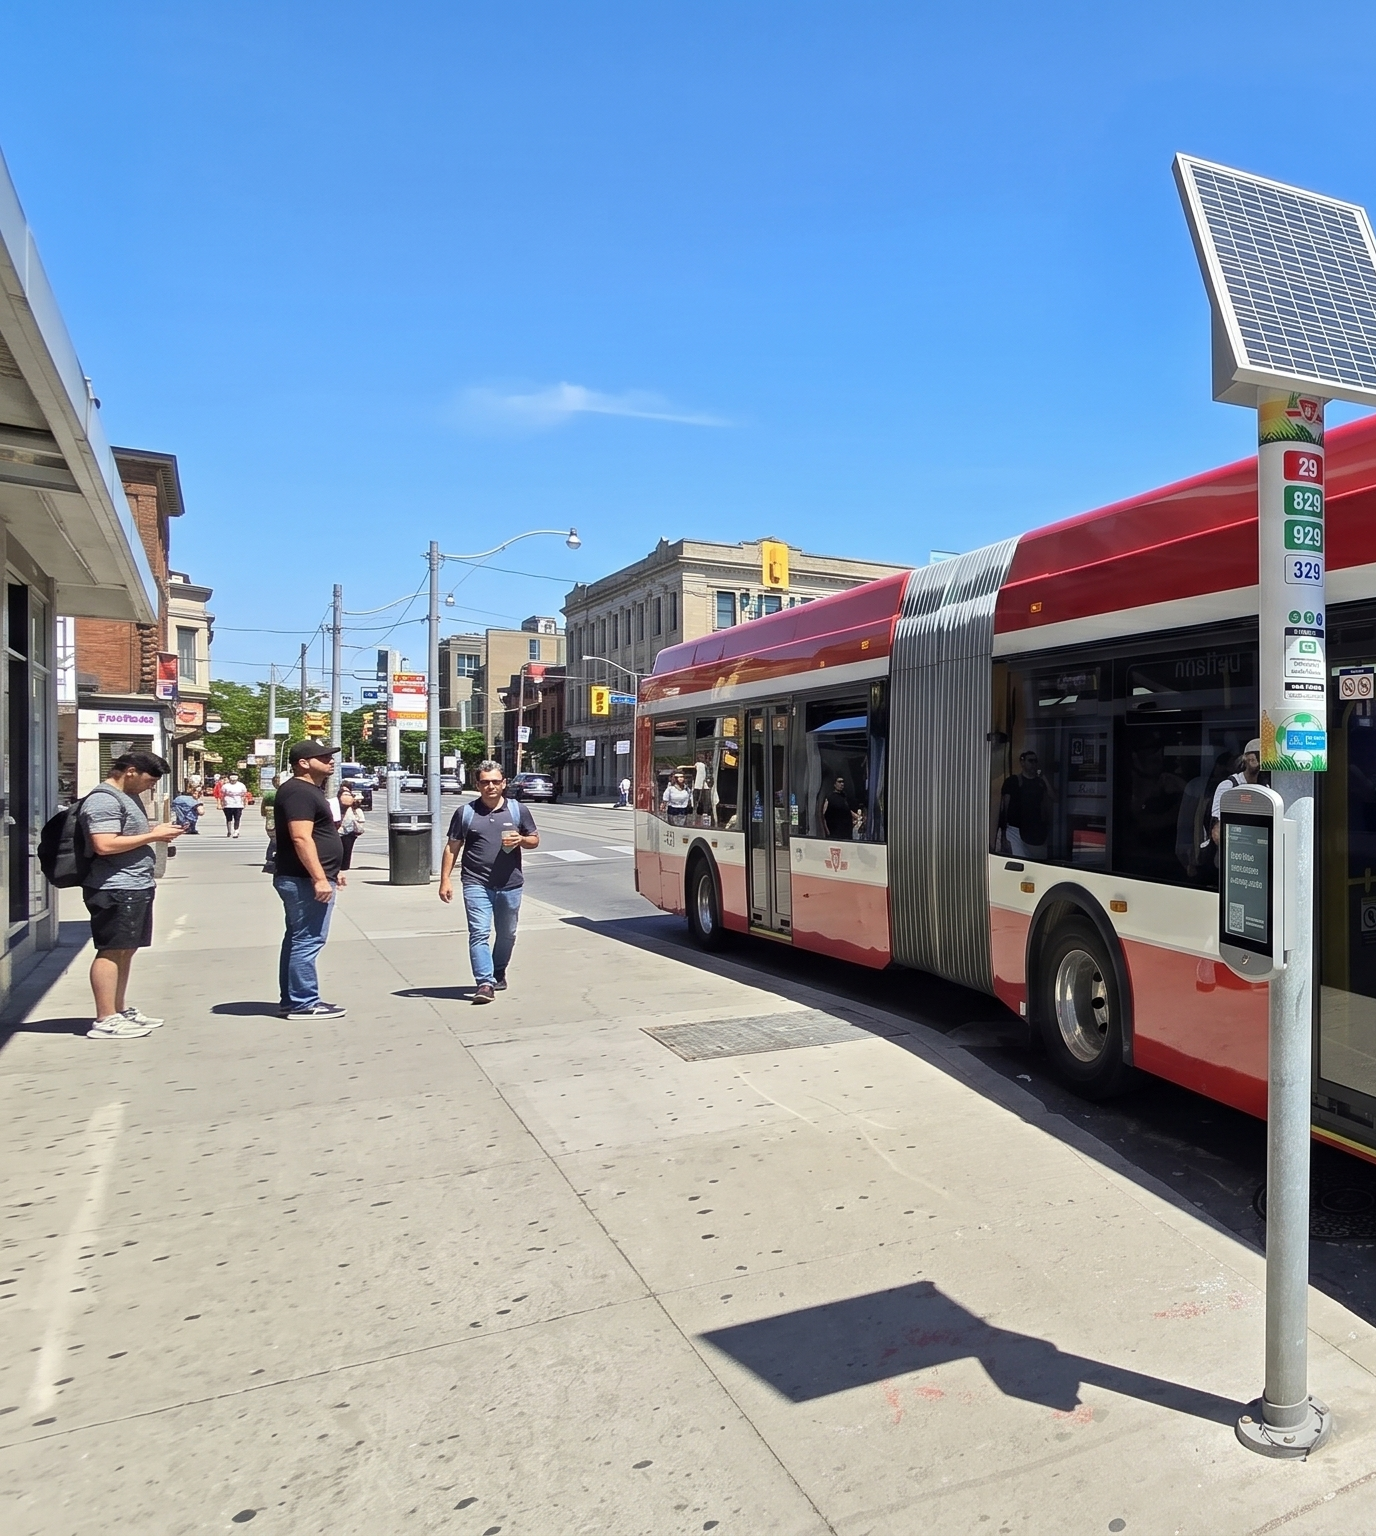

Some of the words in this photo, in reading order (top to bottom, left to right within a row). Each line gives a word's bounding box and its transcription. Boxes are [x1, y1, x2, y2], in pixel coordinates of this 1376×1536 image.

[1299, 457, 1318, 478] 29
[1293, 491, 1321, 513] 829
[1293, 525, 1321, 547] 929
[1293, 561, 1321, 581] 329
